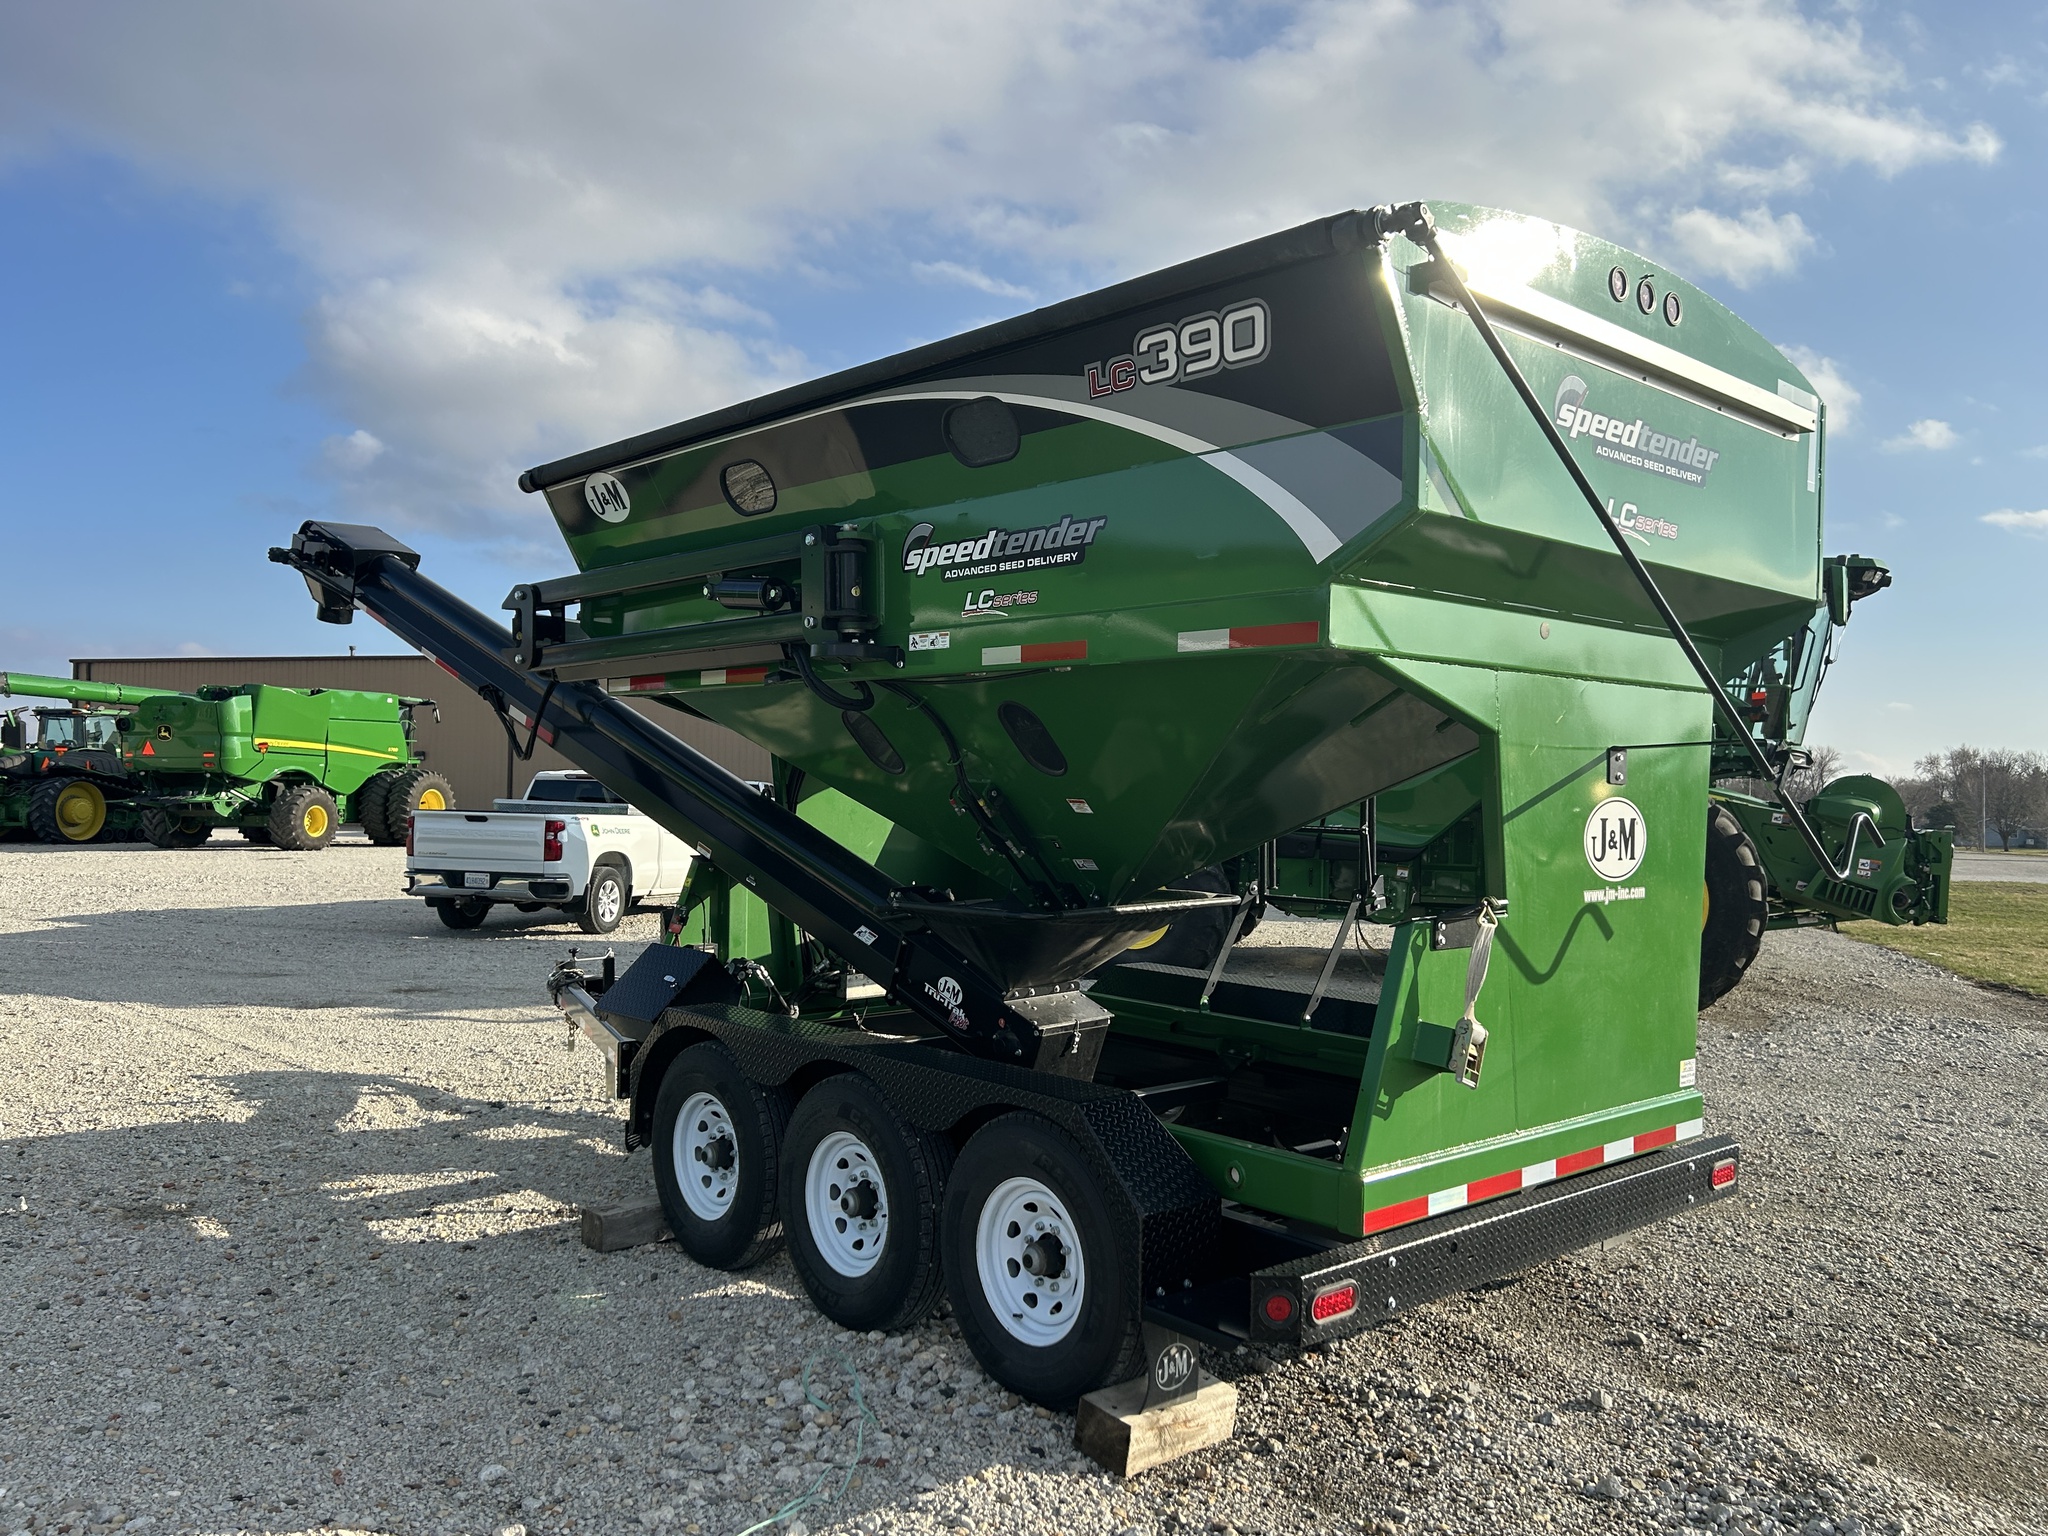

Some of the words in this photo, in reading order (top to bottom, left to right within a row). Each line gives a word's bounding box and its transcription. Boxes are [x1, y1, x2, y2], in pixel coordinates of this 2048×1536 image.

[1596, 445, 1642, 466] ADVANCED
[1644, 460, 1664, 473] SEED
[1666, 465, 1702, 483] DELIVERY
[590, 480, 628, 515] J&M
[944, 564, 997, 579] ADVANCED
[999, 559, 1025, 571] SEED
[1027, 551, 1078, 567] DELIVERY
[1591, 817, 1637, 862] J&M
[1583, 885, 1646, 905] www.jm-inc.com
[940, 979, 961, 1004] J&M
[1158, 1349, 1188, 1384] J&M
